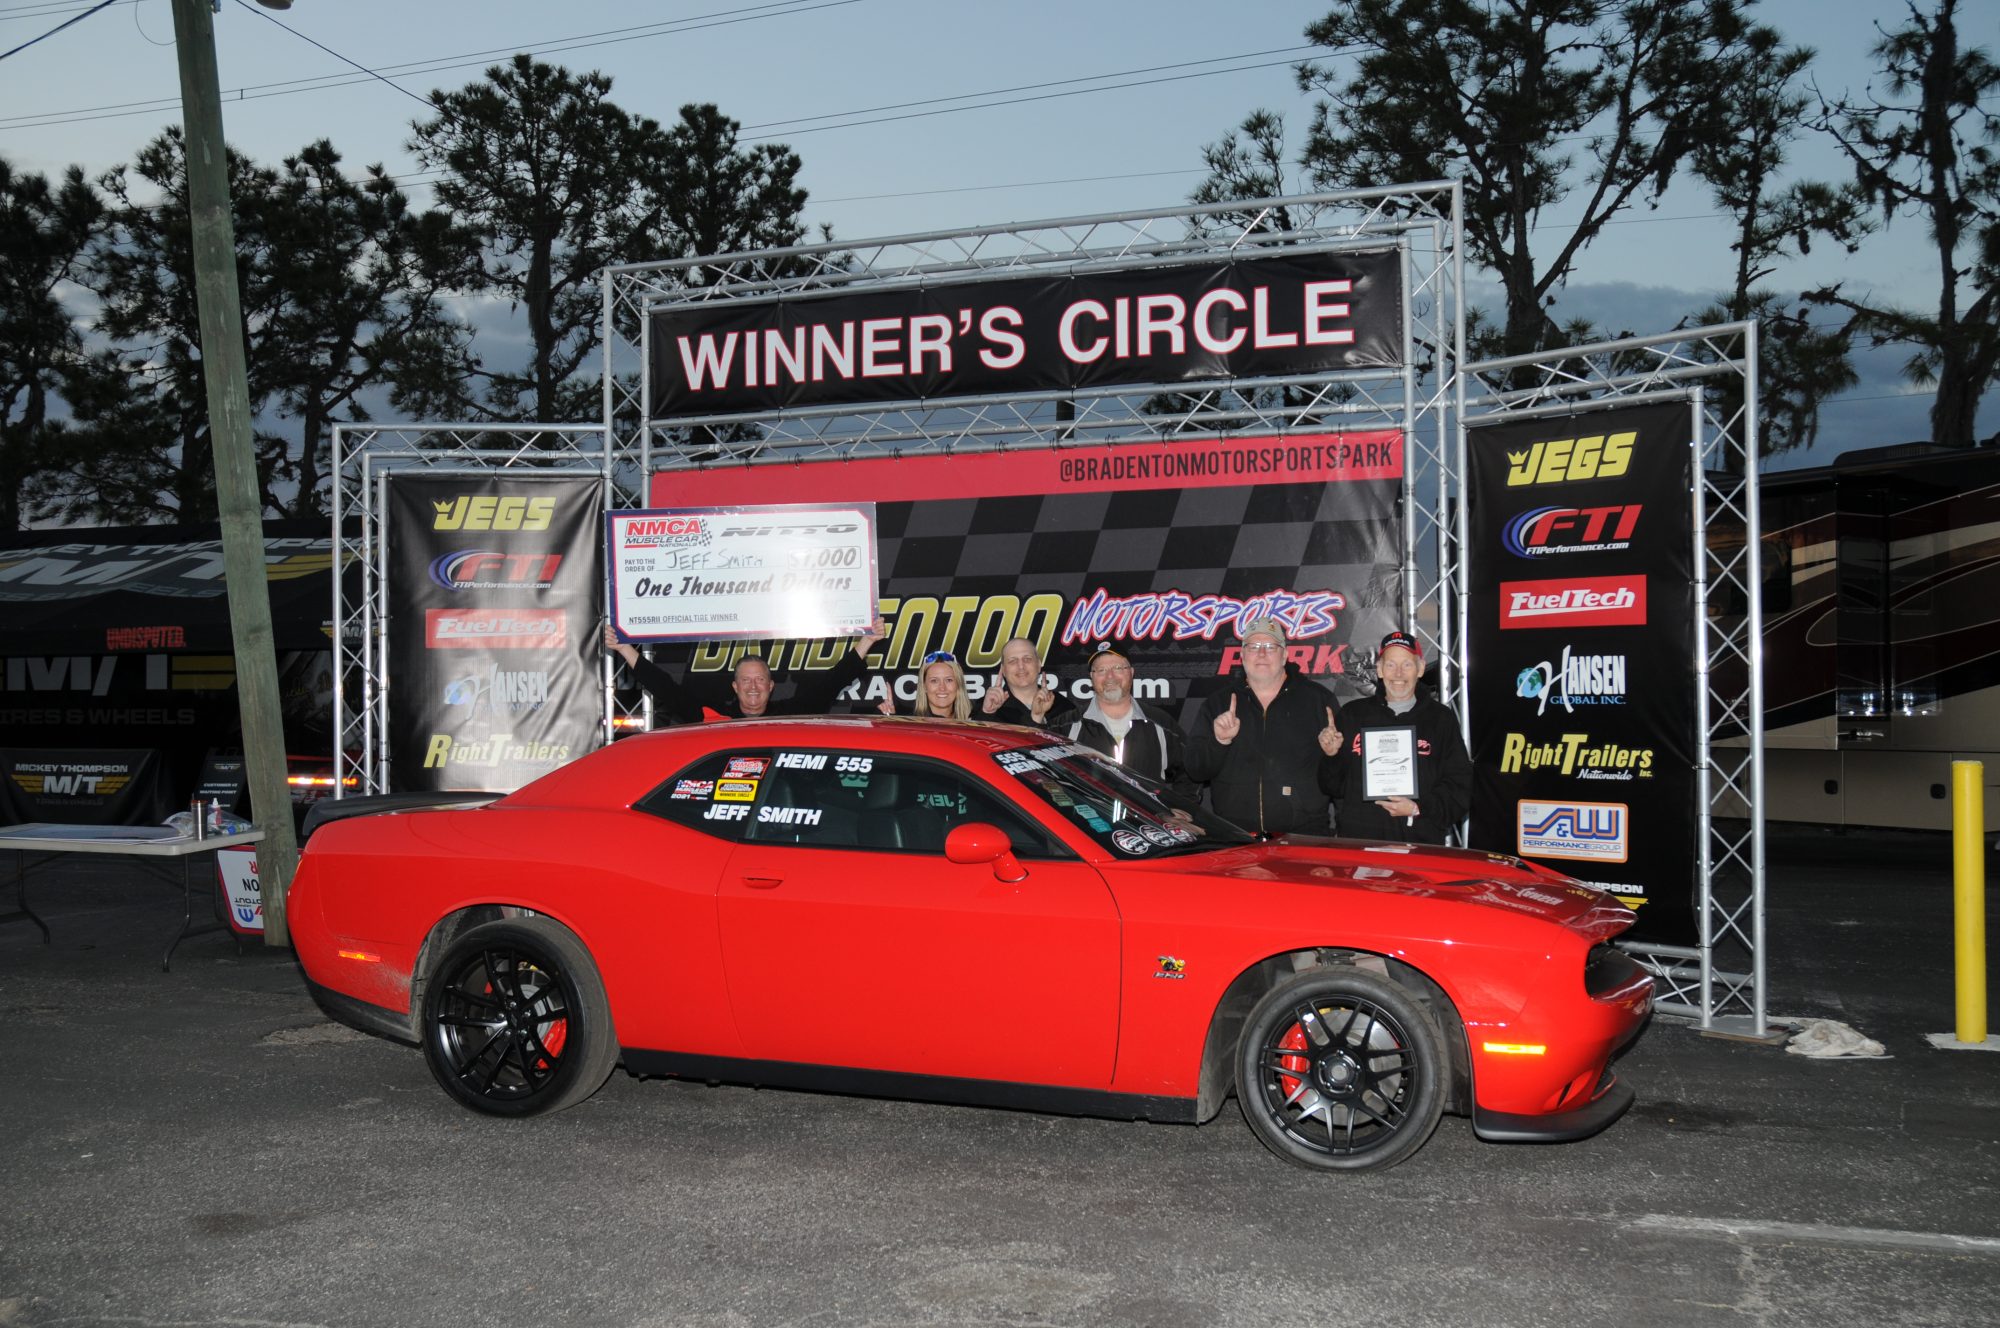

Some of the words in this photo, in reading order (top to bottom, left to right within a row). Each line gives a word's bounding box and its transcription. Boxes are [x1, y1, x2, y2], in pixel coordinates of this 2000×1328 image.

[677, 306, 1026, 391] WINNER'S
[1058, 279, 1354, 364] CIRCLE
[1060, 442, 1393, 482] @BRADENTONMOTORSPORTSPARK
[1507, 432, 1637, 486] JEGS
[433, 497, 556, 530] JEGS
[1528, 504, 1642, 545] FTI
[625, 519, 702, 537] NMCA
[625, 536, 673, 545] MUSCLE
[674, 535, 700, 543] CAR
[1526, 542, 1629, 555] FTIPerformance.com
[456, 553, 563, 581] FTI
[665, 547, 712, 570] JEFF
[453, 581, 551, 589] FTIPerformance.com
[635, 577, 672, 598] One
[679, 573, 774, 596] Thousand
[1510, 587, 1635, 611] FuelTech
[663, 614, 693, 623] OFFICIAL
[694, 614, 709, 622] TIRE
[710, 613, 738, 621] WINNER
[1061, 587, 1346, 646] MOTORSPORTS
[436, 618, 556, 638] FuelTech
[1217, 644, 1348, 676] PRK
[837, 673, 1170, 701] RACBP.cm
[1517, 645, 1626, 717] HANSEN
[1550, 695, 1599, 705] GLOBAL
[1600, 695, 1627, 705] INC.
[0, 707, 64, 726] IRES
[86, 707, 198, 726] WHEELS
[15, 763, 60, 773] MICKEY
[61, 764, 128, 773] THOMPSON
[775, 753, 828, 770] HEMI
[834, 756, 874, 773] 555
[995, 751, 1026, 764] 555
[43, 774, 103, 796] M/T
[1576, 768, 1634, 781] Nationwide
[703, 804, 751, 821] JEFF
[757, 806, 822, 826] SMITH
